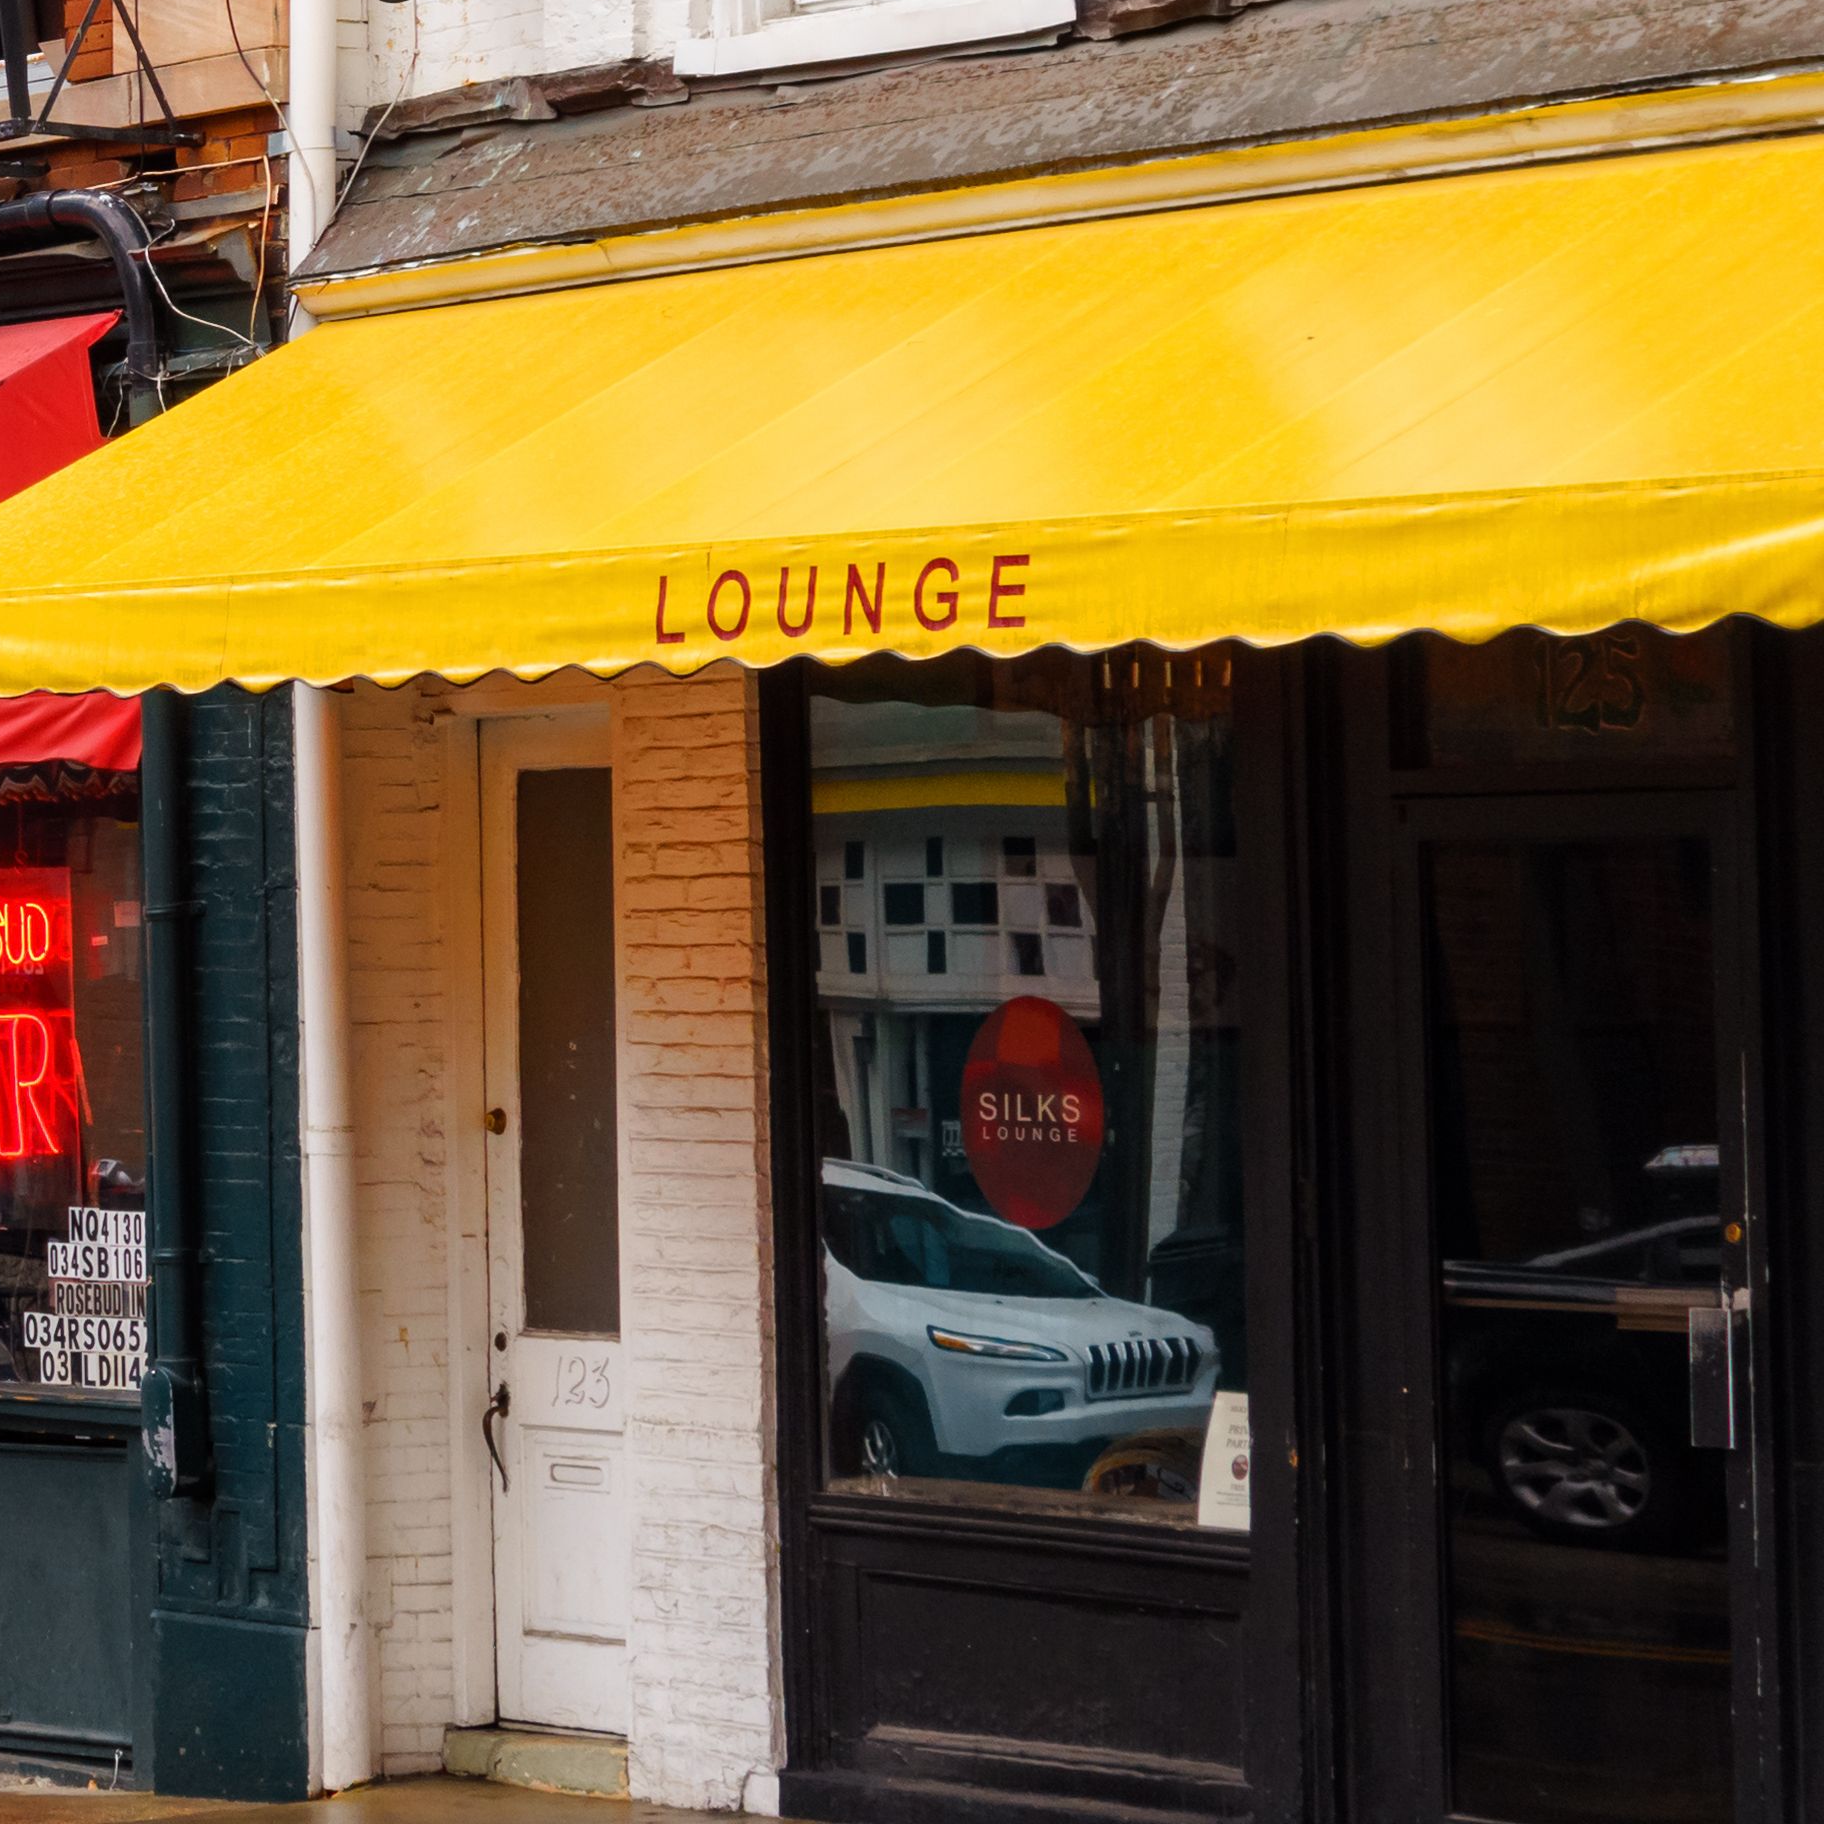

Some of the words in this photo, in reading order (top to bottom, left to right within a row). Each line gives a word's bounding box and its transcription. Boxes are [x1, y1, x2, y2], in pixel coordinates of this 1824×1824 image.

[656, 554, 1030, 644] LOUNGE
[978, 1092, 1081, 1124] SILKS
[982, 1126, 1079, 1143] LOUNGE
[70, 1210, 143, 1246] NQ4130
[49, 1244, 144, 1280] 034SB106
[56, 1283, 122, 1316] ROSEBUD
[552, 1356, 611, 1409] 123
